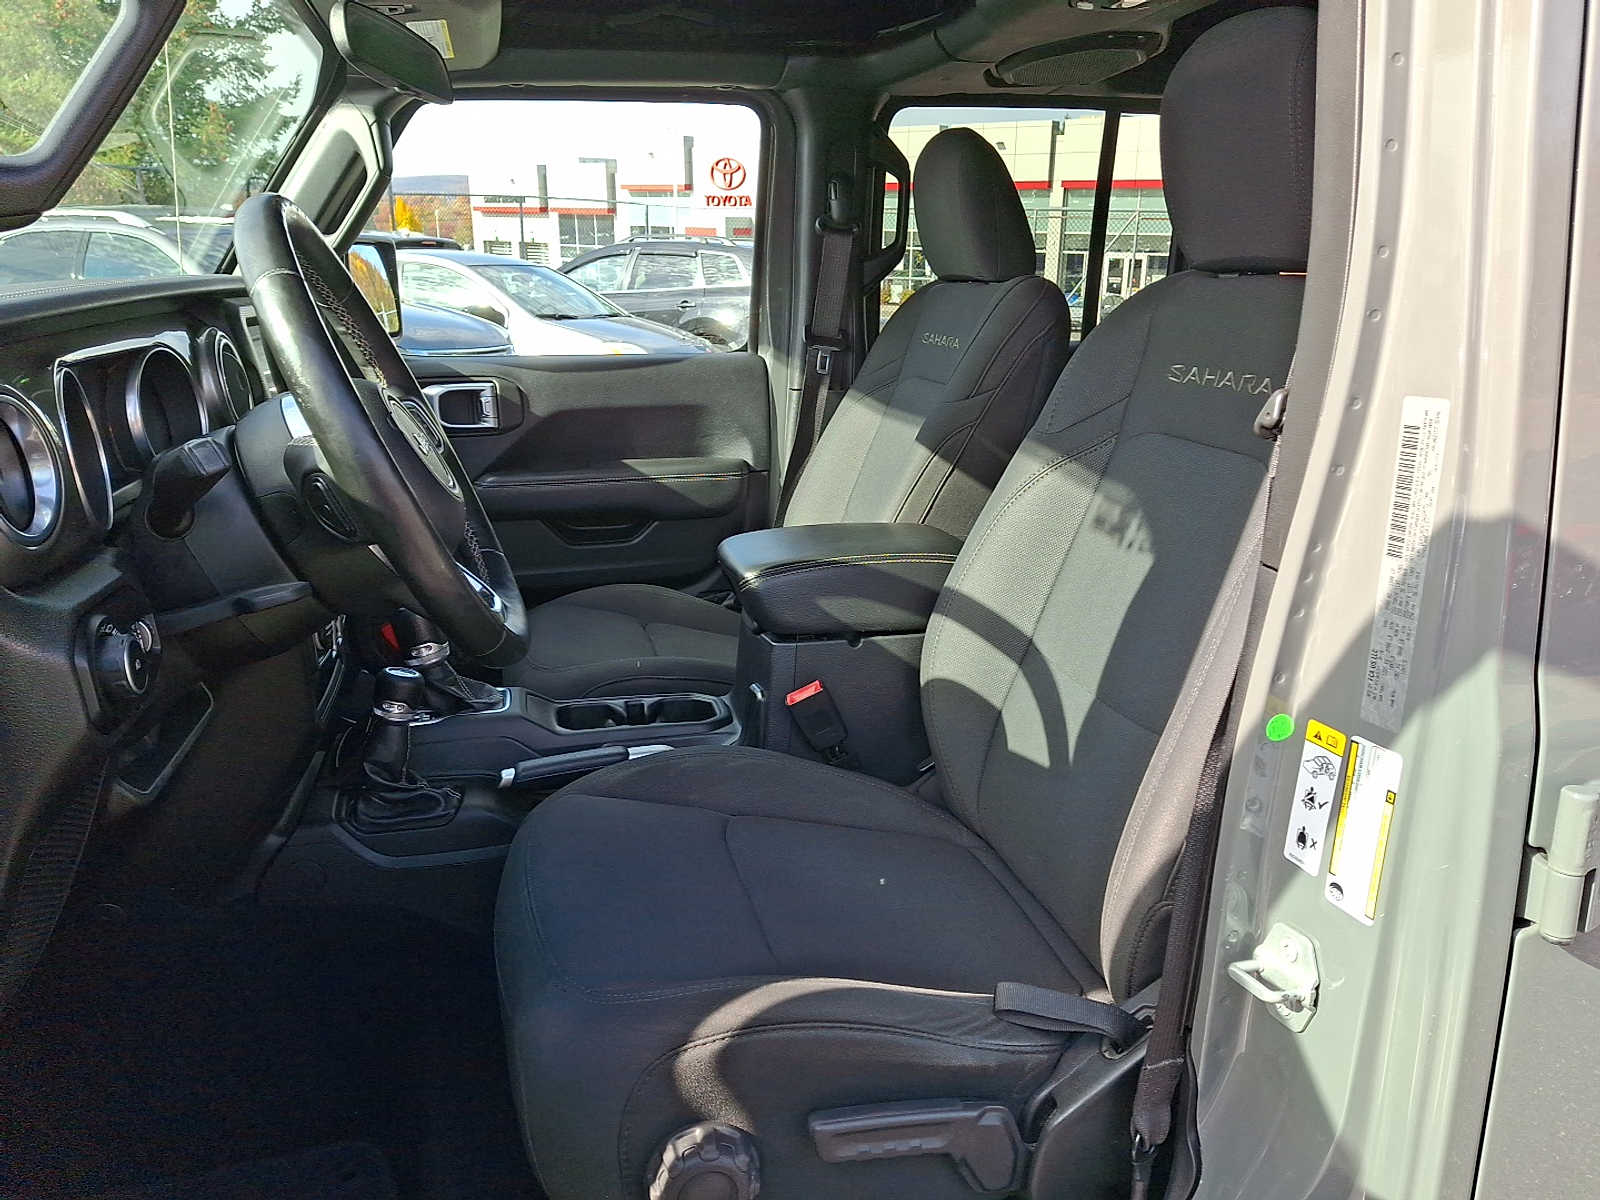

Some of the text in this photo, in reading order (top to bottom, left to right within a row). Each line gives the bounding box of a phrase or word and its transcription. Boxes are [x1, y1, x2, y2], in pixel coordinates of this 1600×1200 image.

[704, 194, 752, 207] TOYOTA
[921, 332, 960, 350] SAHARA
[1167, 364, 1272, 395] SAHARA
